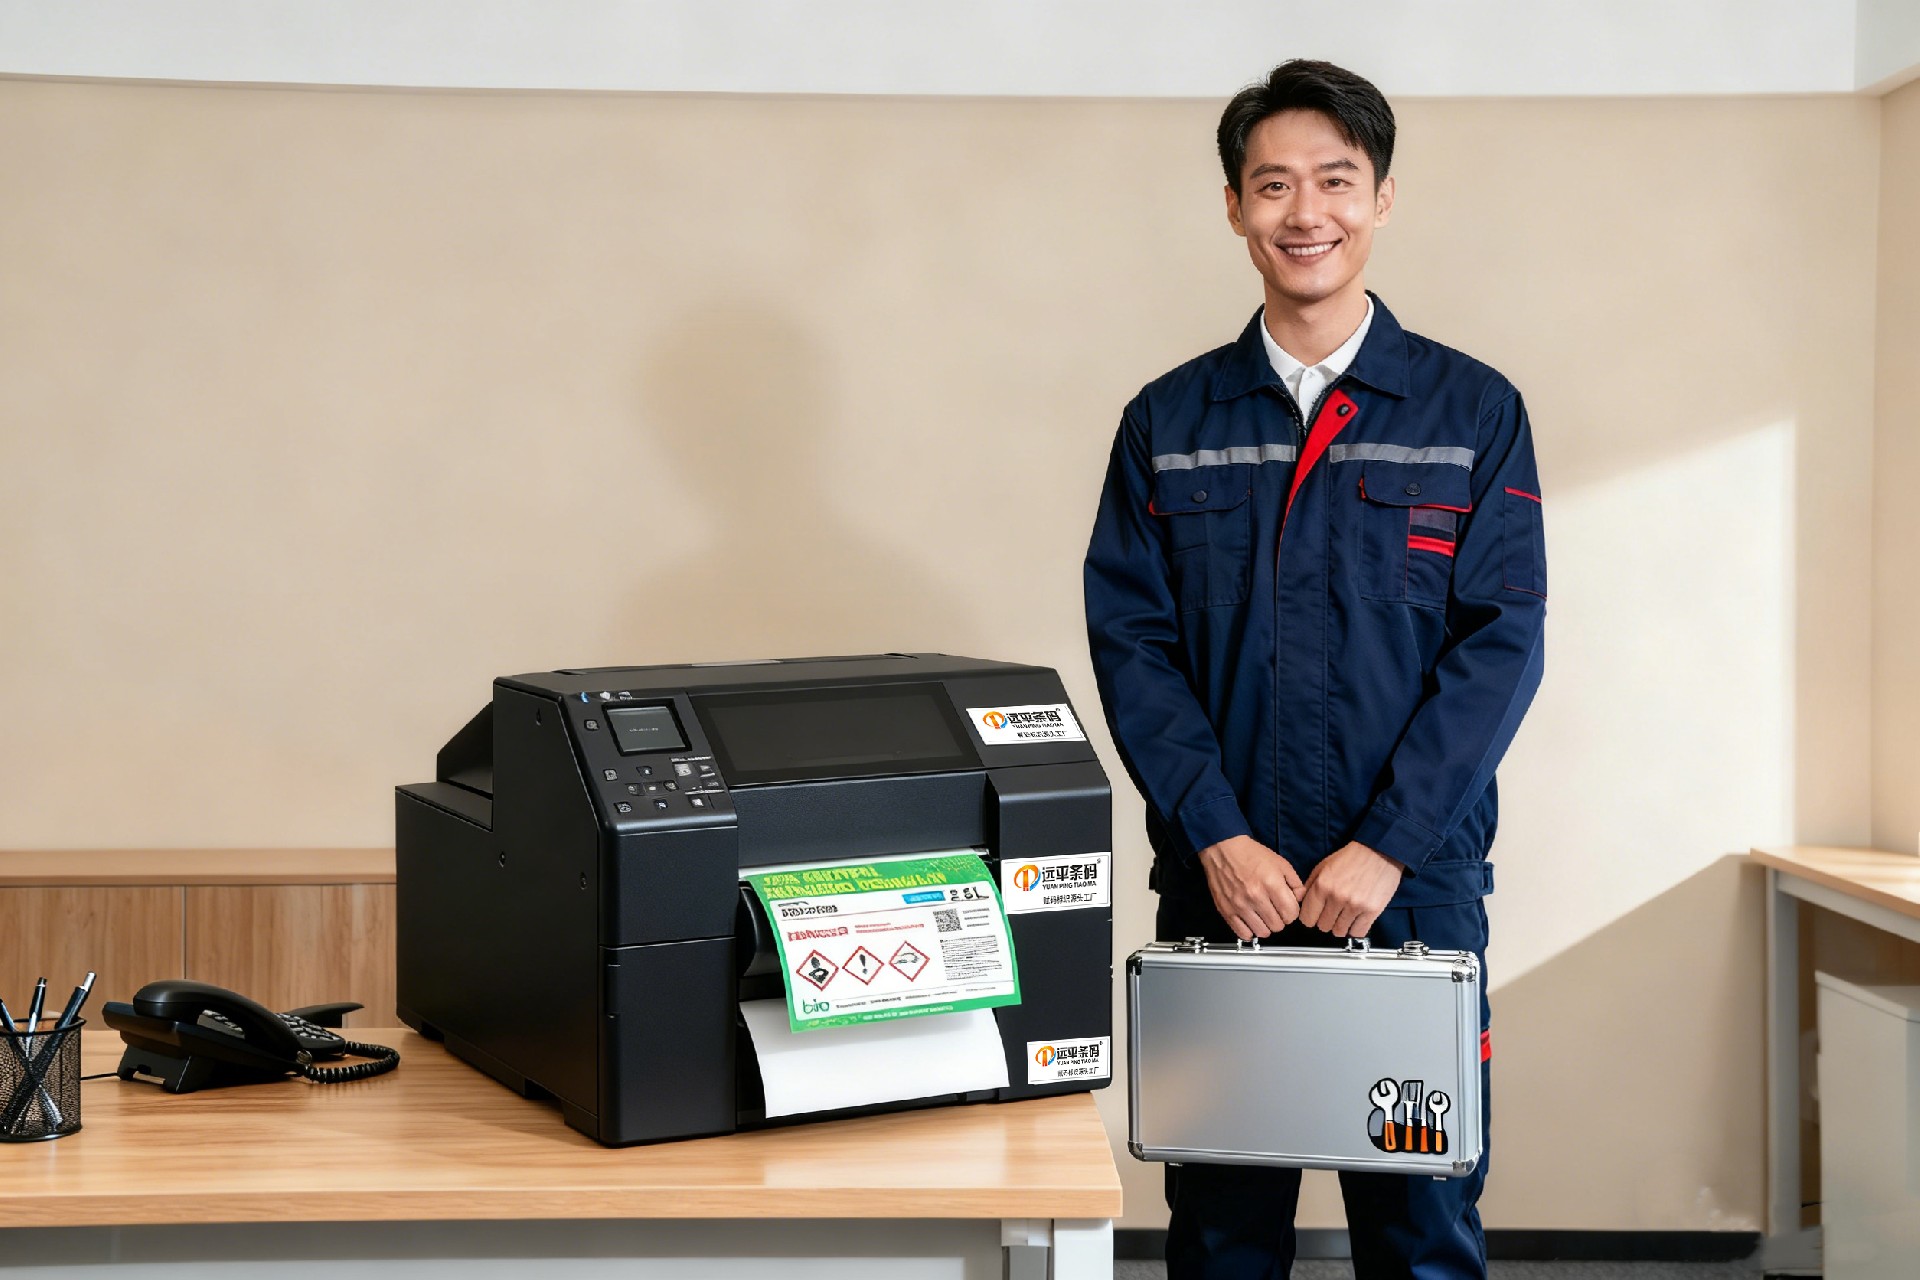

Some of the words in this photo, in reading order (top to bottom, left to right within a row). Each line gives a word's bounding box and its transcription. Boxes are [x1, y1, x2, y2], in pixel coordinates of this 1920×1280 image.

[1042, 863, 1098, 882] 远平条码
[802, 999, 830, 1014] bio
[1056, 1044, 1100, 1060] 远平条码
